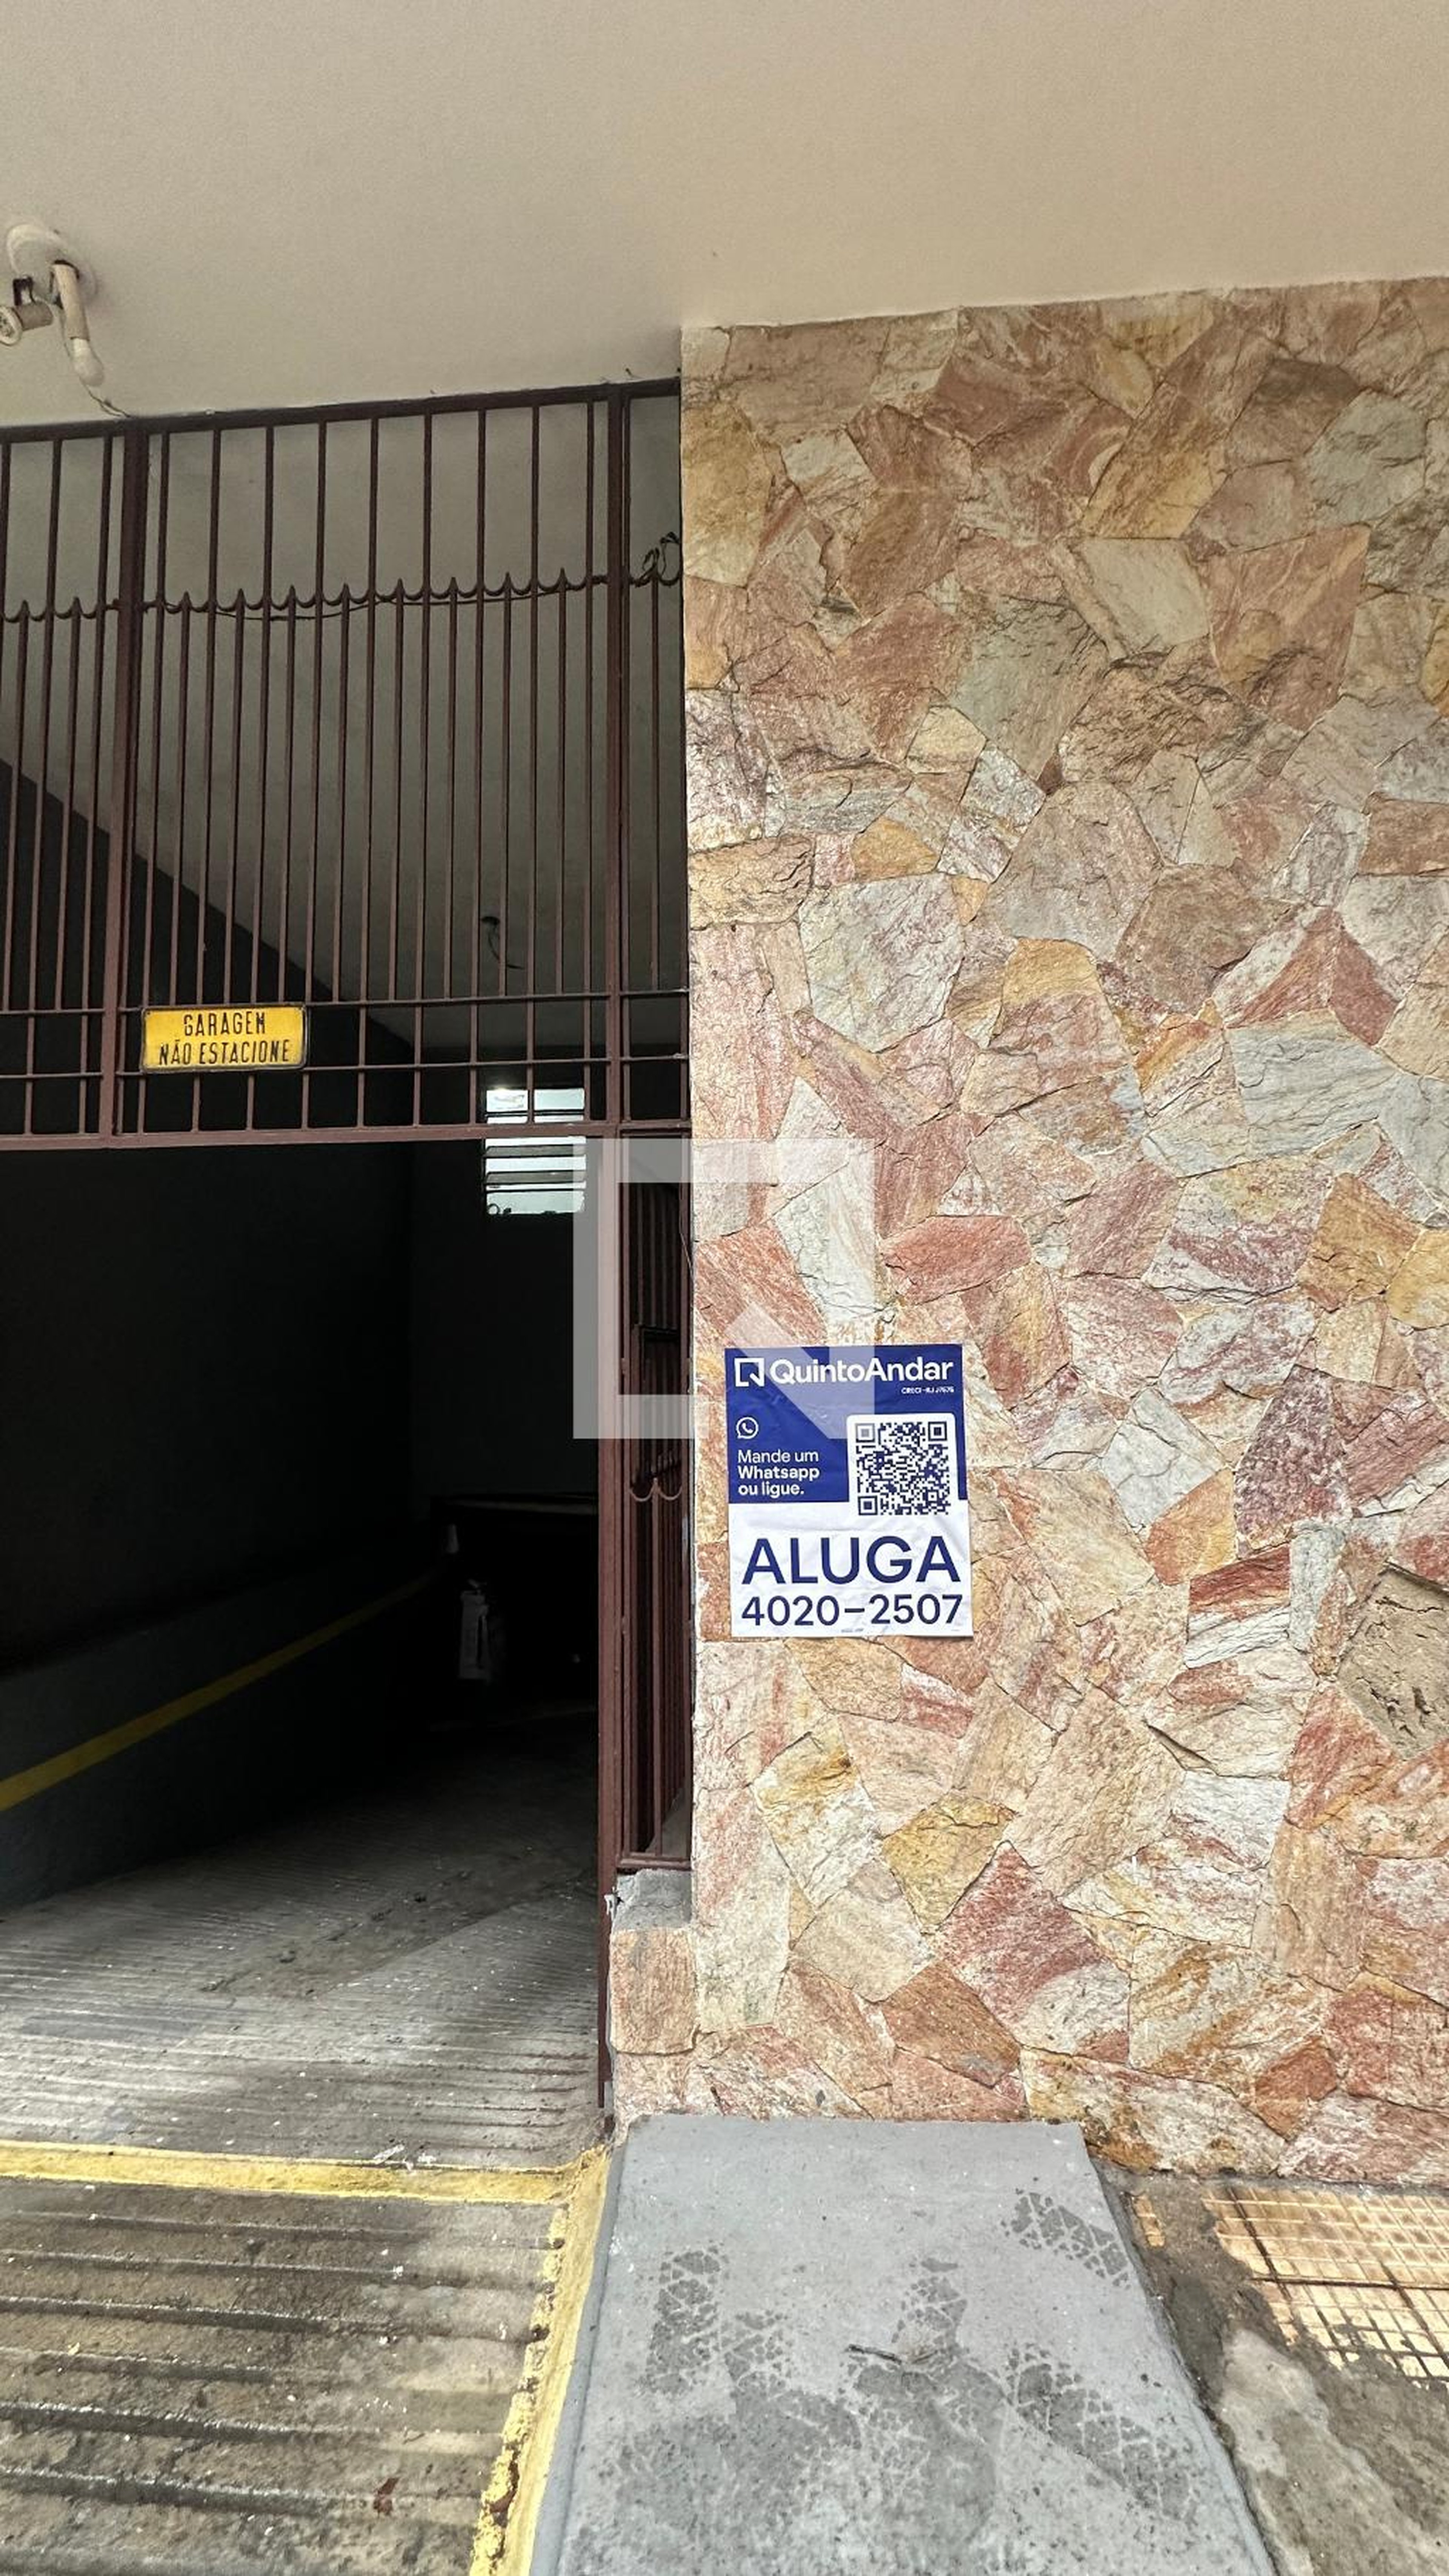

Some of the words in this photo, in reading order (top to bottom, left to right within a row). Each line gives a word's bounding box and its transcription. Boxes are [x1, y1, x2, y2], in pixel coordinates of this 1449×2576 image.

[184, 1011, 266, 1036] GARAGEM
[159, 1040, 192, 1065] NÃO
[199, 1039, 290, 1065] ESTACIONE
[770, 1357, 953, 1384] QuintoAndar
[738, 1449, 791, 1463] Mande
[794, 1450, 818, 1462] um
[738, 1465, 820, 1481] Whatsapp
[738, 1485, 758, 1496] ou
[762, 1481, 804, 1499] ligue.
[741, 1536, 961, 1585] ALUGA
[741, 1594, 963, 1626] 4020-2507
